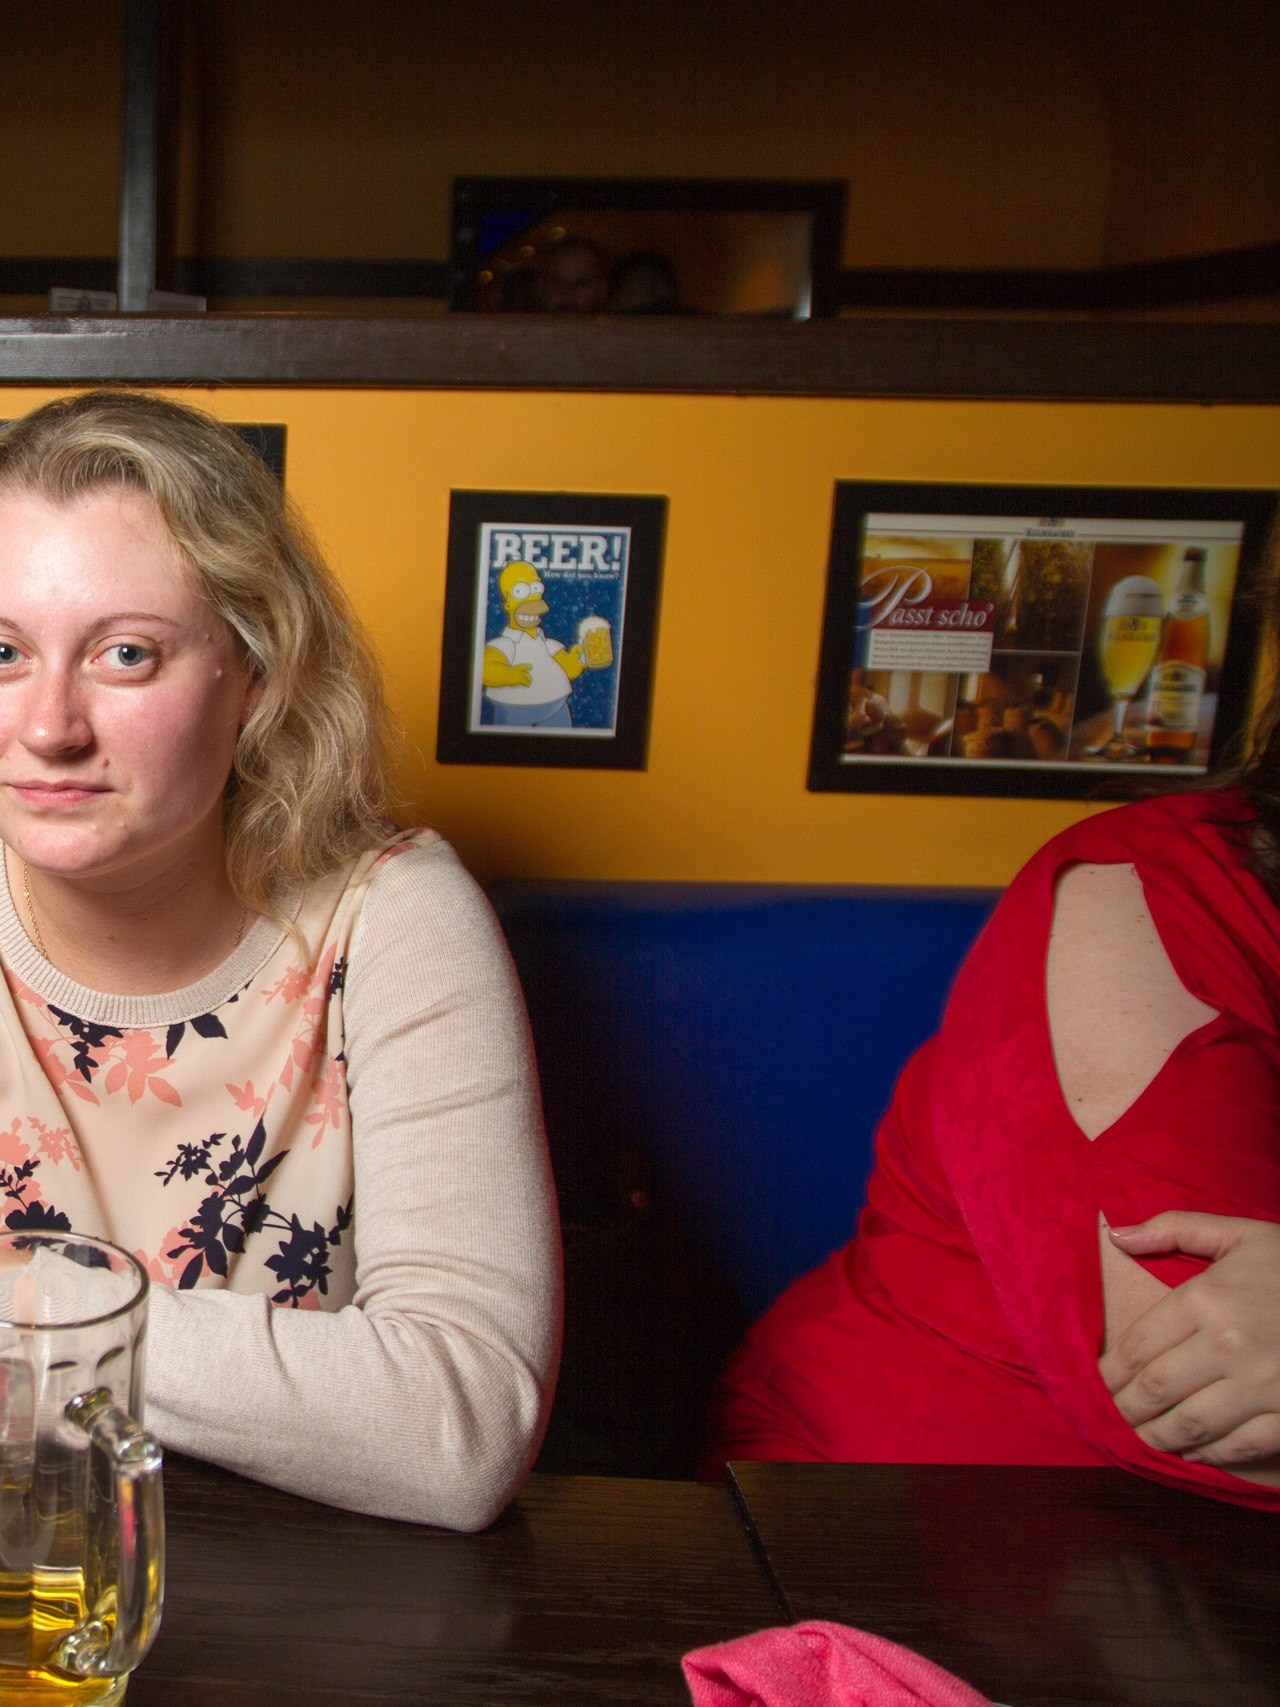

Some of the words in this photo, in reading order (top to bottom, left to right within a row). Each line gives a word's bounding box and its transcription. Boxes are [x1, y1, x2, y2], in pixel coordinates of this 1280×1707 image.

[494, 533, 622, 571] BEER!
[543, 569, 561, 578] How
[563, 570, 576, 579] did
[577, 571, 592, 581] you
[593, 571, 620, 581] know?
[855, 565, 934, 631] Passt
